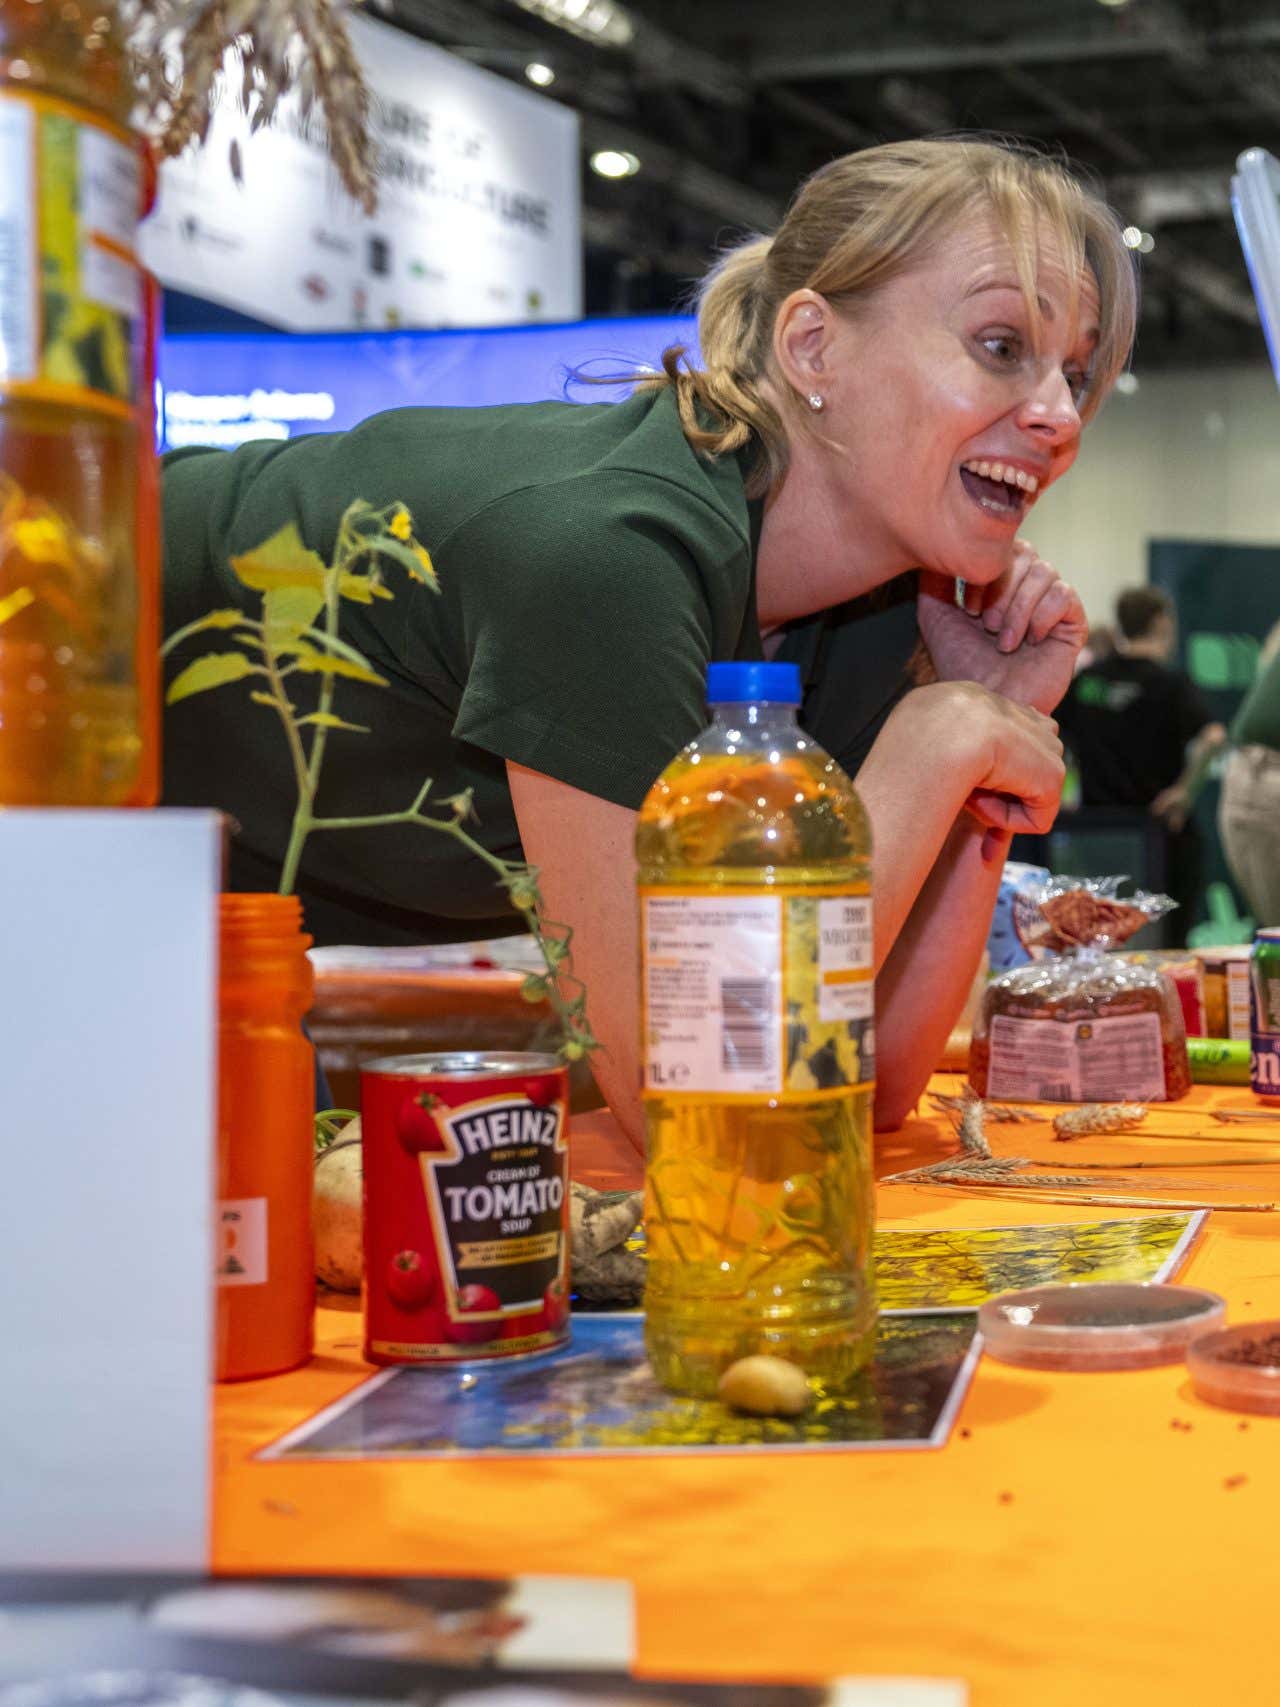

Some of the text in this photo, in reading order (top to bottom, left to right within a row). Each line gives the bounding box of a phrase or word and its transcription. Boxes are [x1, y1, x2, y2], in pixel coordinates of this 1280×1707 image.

[459, 1108, 557, 1155] HEINZ
[444, 1176, 564, 1222] TOMATO
[501, 1217, 533, 1233] SOUP
